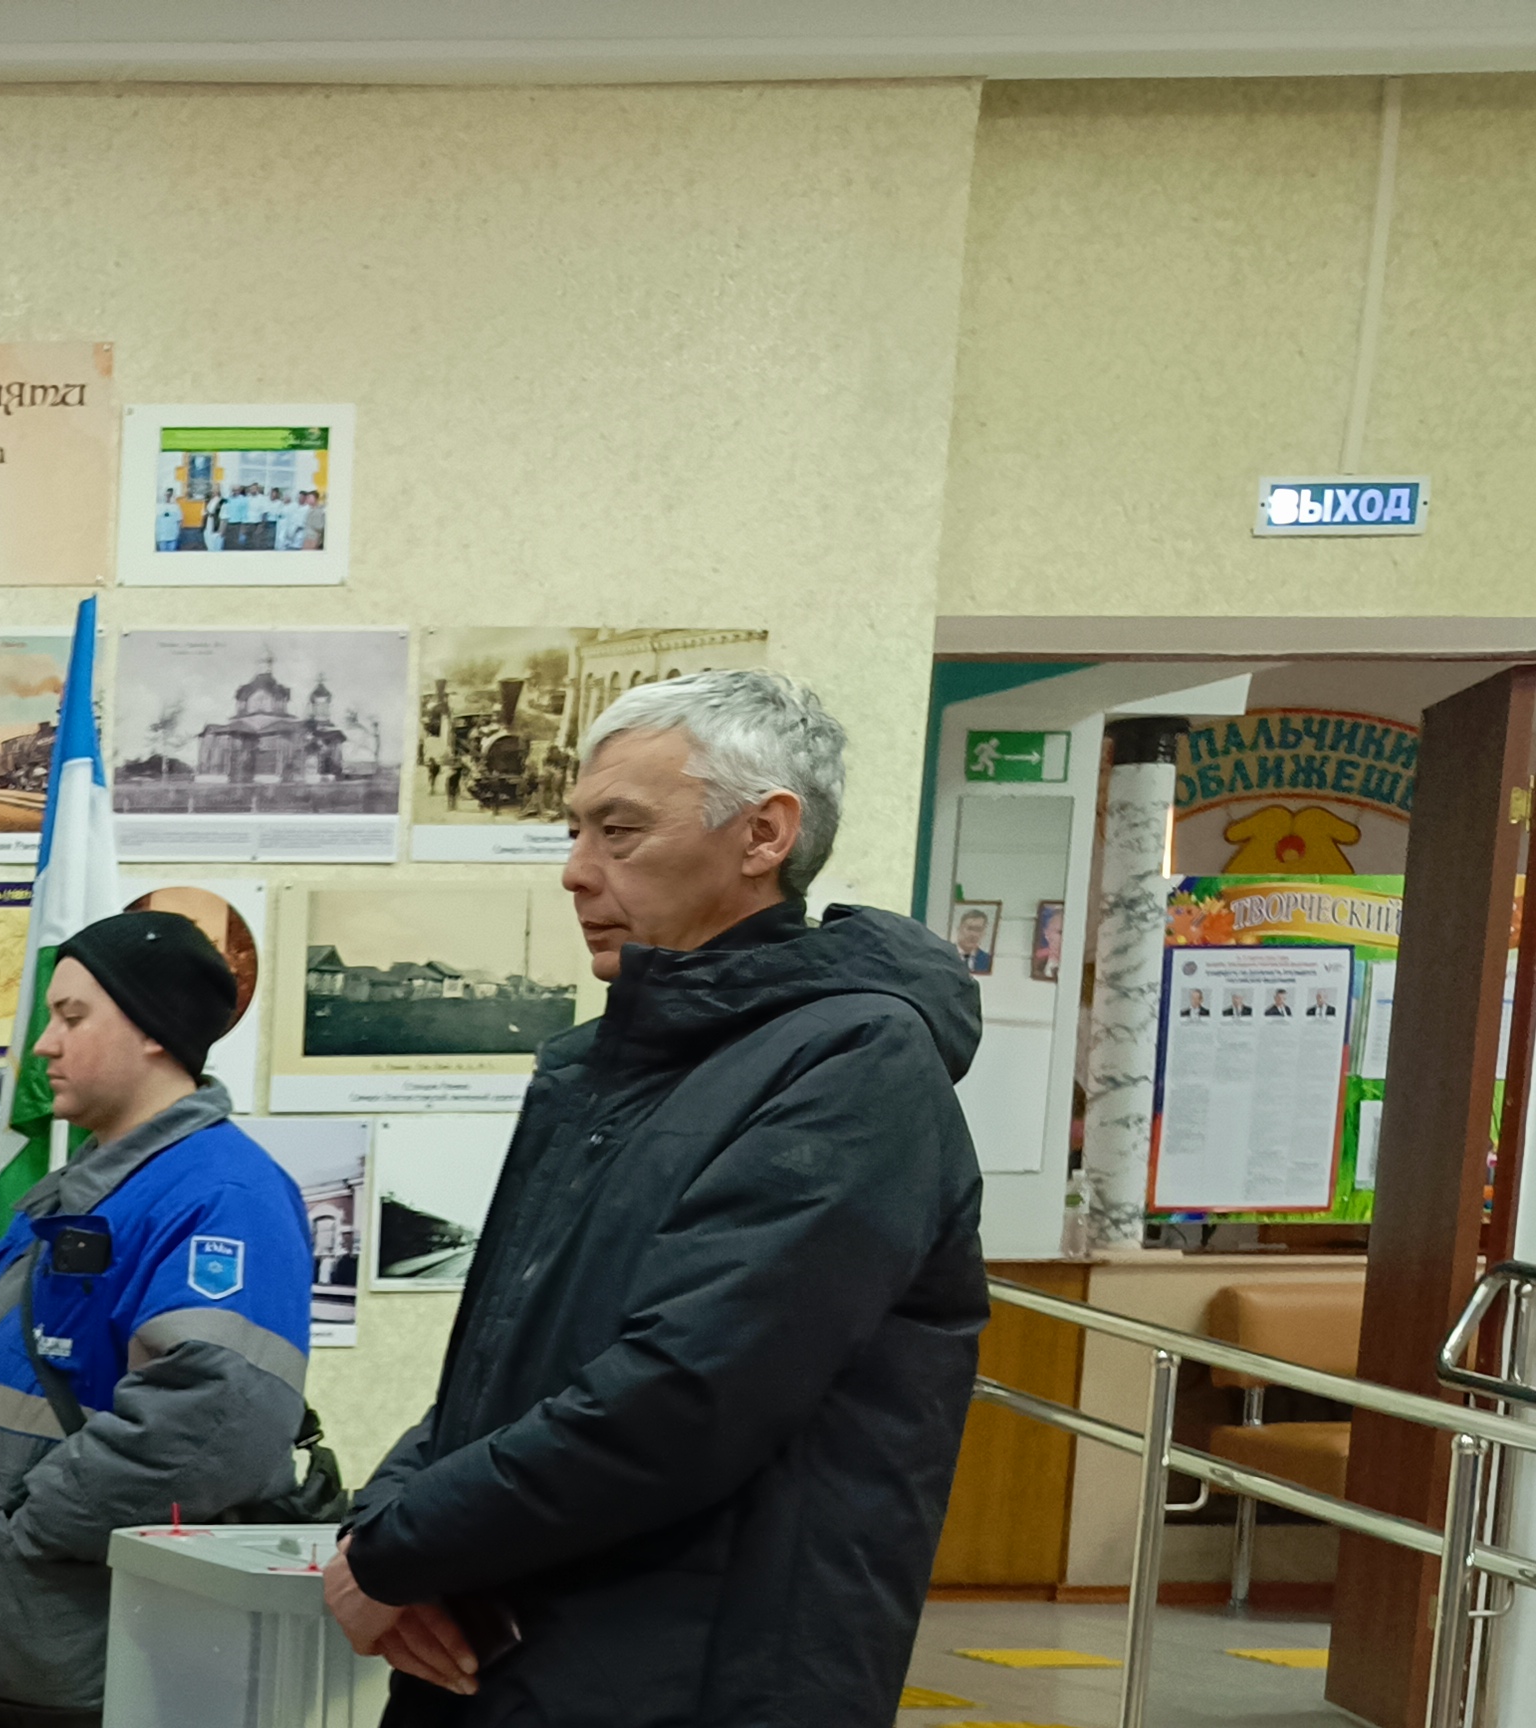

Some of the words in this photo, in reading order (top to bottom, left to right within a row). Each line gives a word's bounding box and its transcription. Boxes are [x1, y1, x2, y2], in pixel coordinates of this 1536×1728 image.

[1267, 487, 1411, 525] ВЫХОД
[1187, 716, 1420, 771] ПАЛЬЧИКИ
[1229, 891, 1403, 936] ТВОРЧЕСКИЙ
